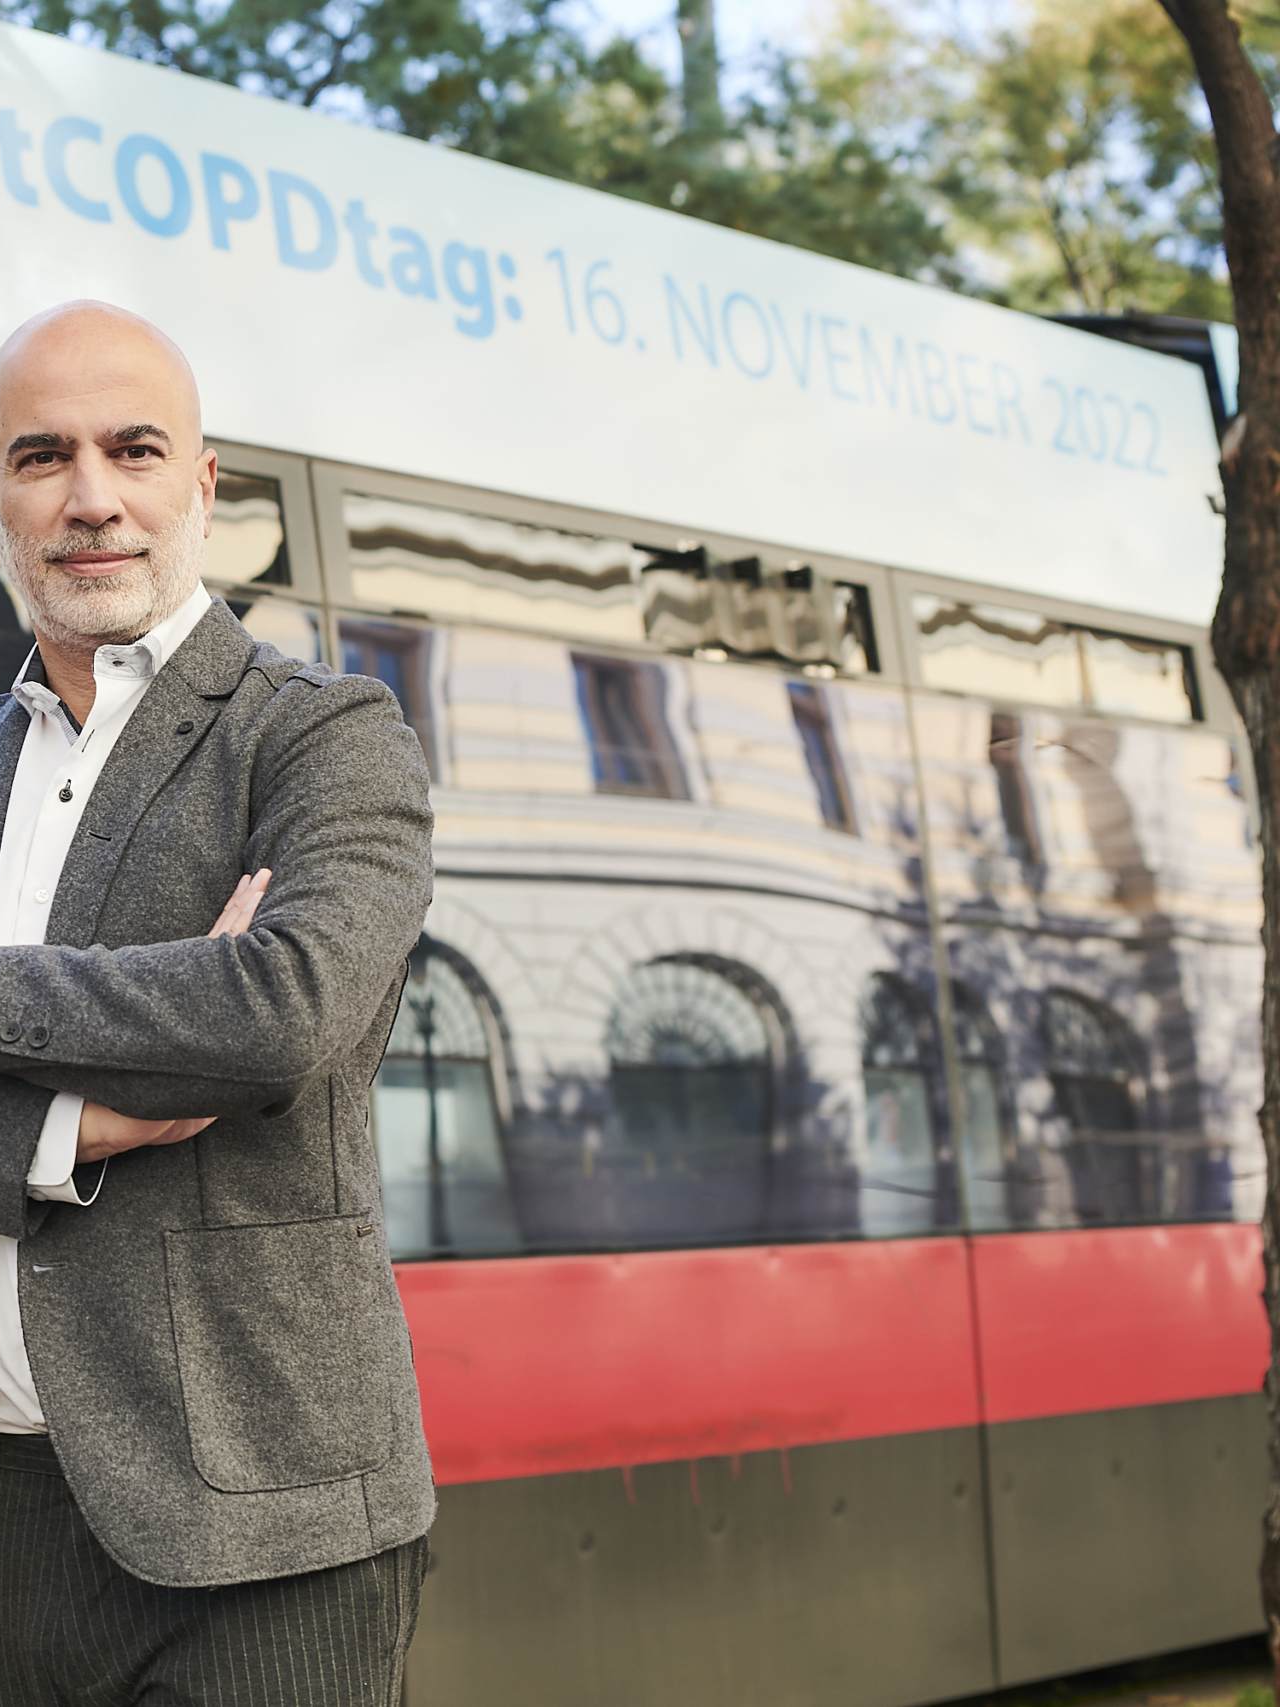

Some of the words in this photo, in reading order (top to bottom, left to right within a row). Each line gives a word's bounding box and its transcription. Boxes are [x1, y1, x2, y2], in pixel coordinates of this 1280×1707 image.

[545, 247, 647, 353] 16.
[662, 272, 1033, 444] NOVEMBER
[1041, 377, 1169, 478] 2022
